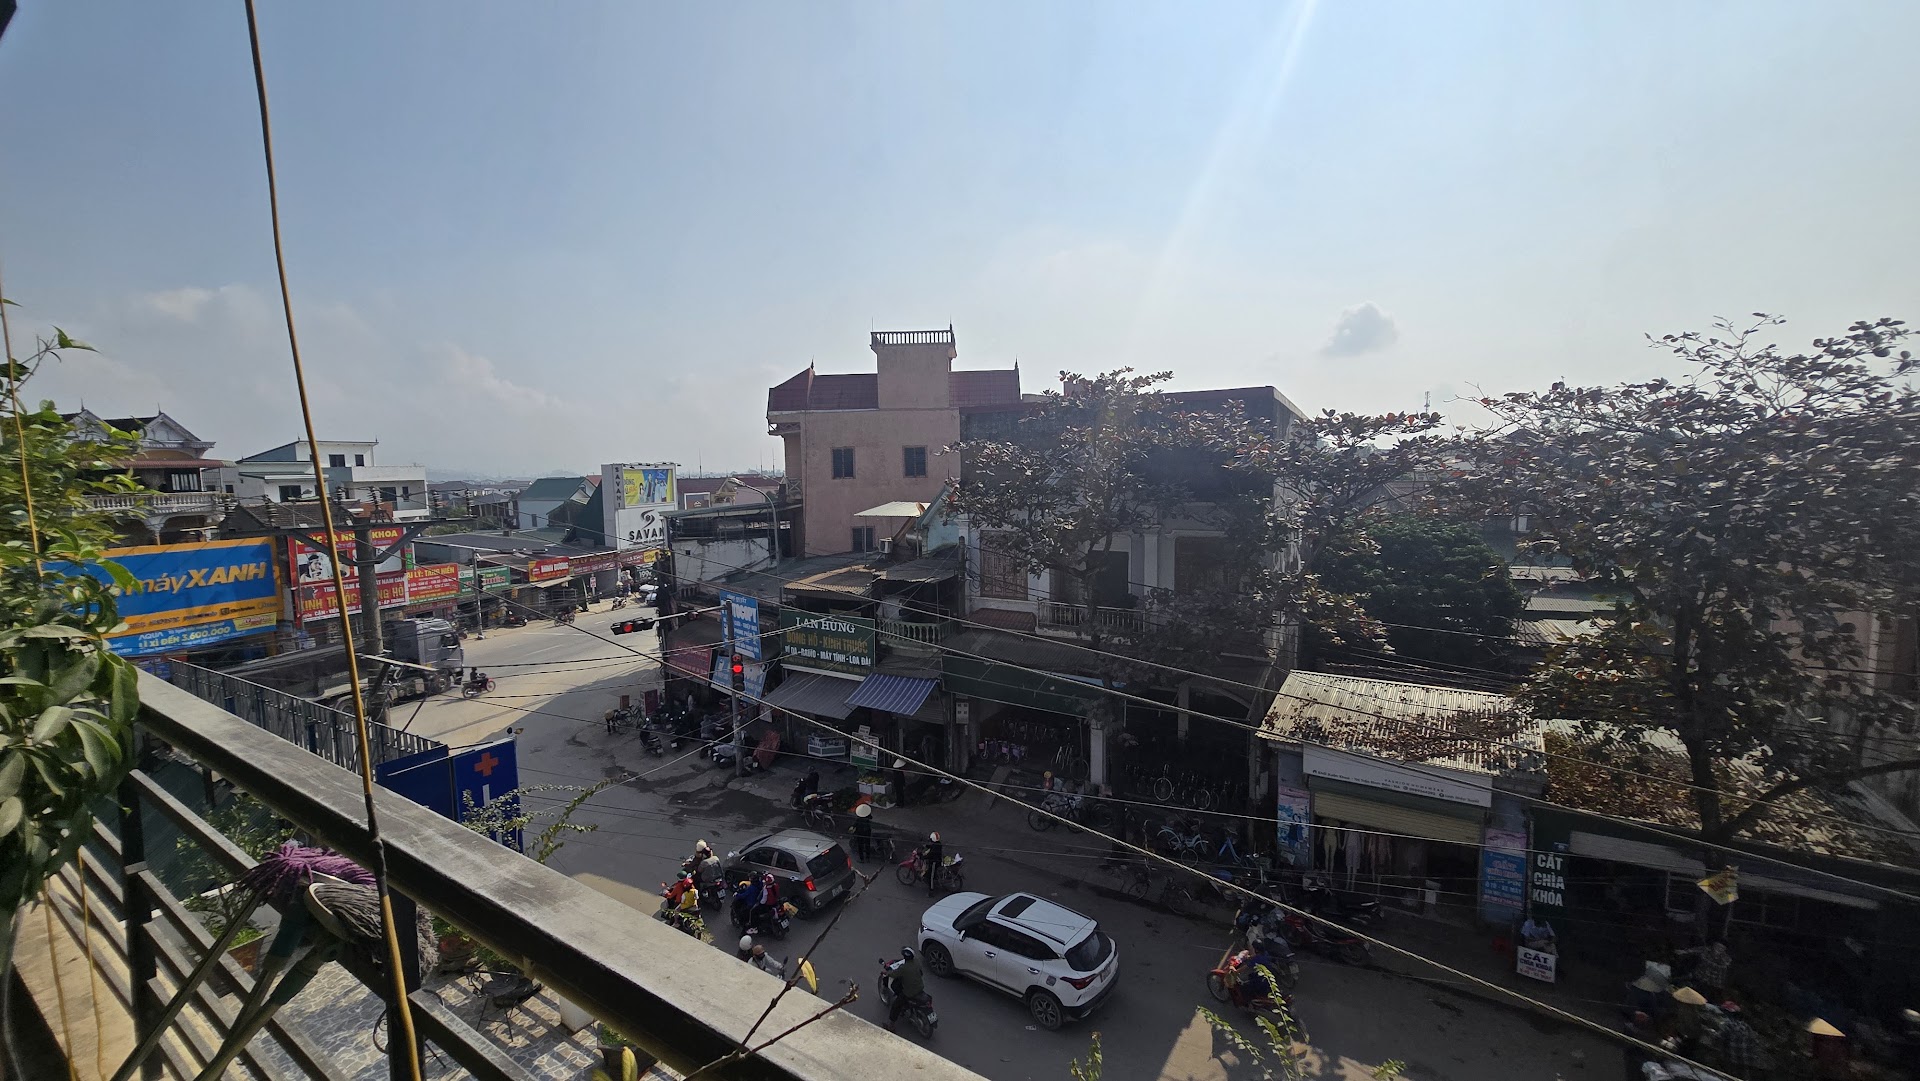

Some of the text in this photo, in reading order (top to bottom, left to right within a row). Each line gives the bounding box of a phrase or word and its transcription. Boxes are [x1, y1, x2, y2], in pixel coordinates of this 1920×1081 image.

[614, 466, 622, 508] SAVANI
[371, 530, 398, 539] KHOA
[629, 527, 665, 542] SAVAN
[186, 562, 267, 590] XANH
[181, 624, 231, 642] 3.600.000
[820, 651, 833, 662] MÁY
[849, 656, 861, 666] LOA
[1537, 852, 1563, 871] CẮT
[1533, 872, 1566, 890] CHÌA
[1532, 889, 1564, 907] KHÓA
